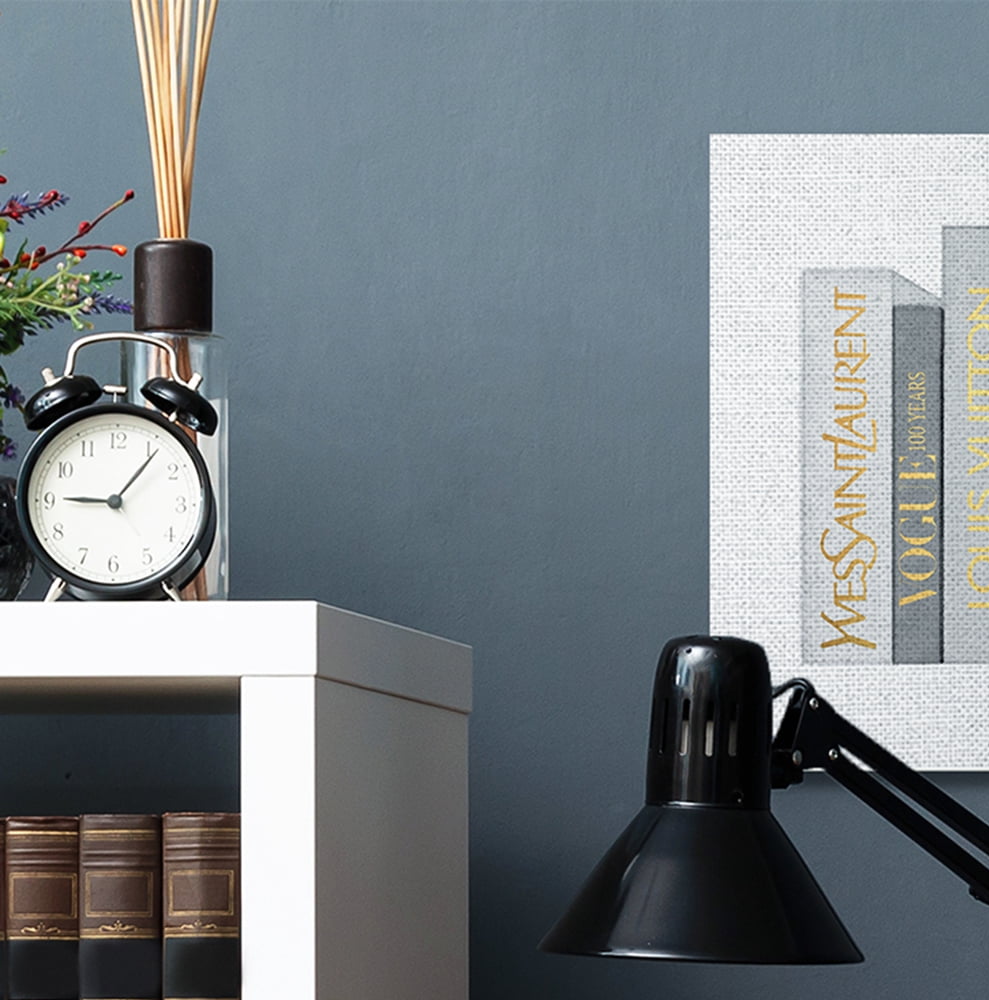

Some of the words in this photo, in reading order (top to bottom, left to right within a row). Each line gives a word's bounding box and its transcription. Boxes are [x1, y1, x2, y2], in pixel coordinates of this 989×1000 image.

[908, 372, 926, 421] YEARS
[110, 432, 127, 449] 12
[908, 425, 926, 453] 100
[81, 440, 94, 457] 11
[58, 462, 73, 478] 10
[167, 463, 178, 480] 2
[44, 492, 55, 510] 9
[175, 496, 187, 513] 3
[52, 523, 64, 540] 8
[164, 526, 176, 542] 4
[899, 454, 937, 607] VOGUE
[78, 548, 88, 564] 7
[108, 555, 119, 573] 6
[142, 548, 153, 565] 5
